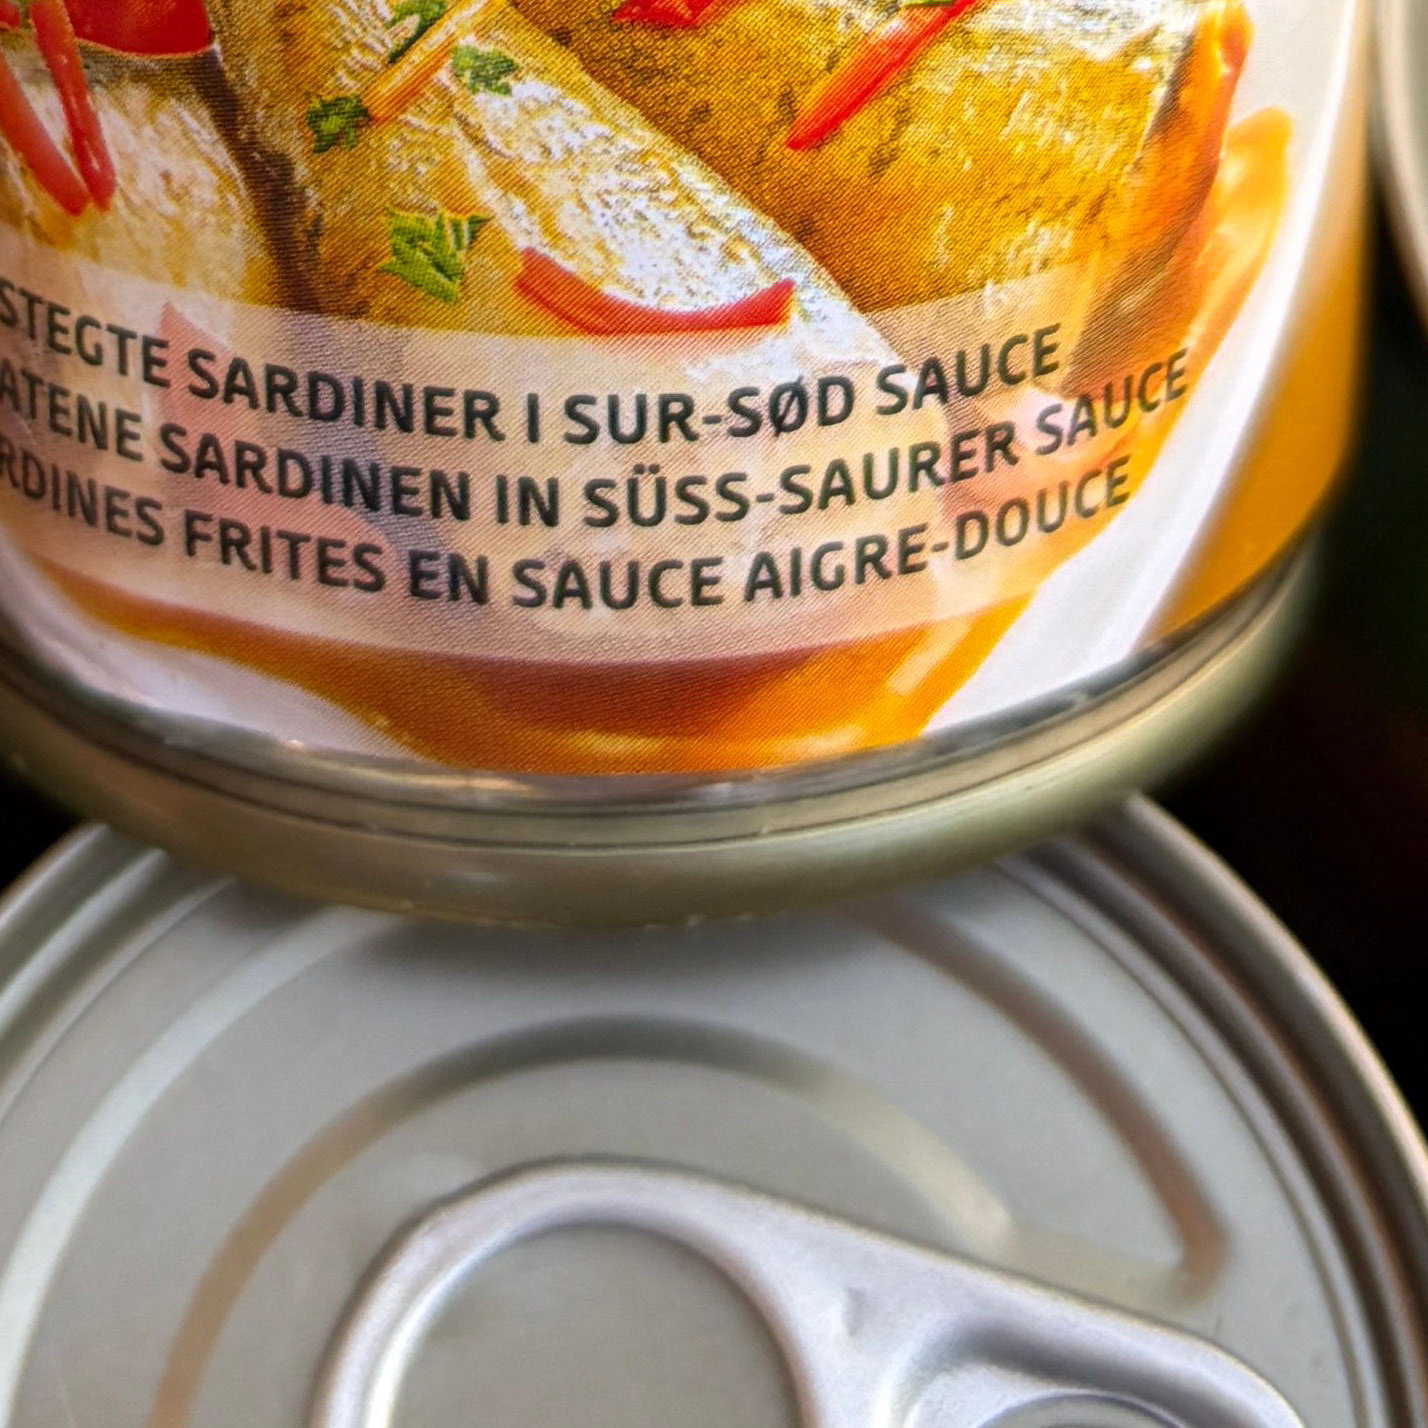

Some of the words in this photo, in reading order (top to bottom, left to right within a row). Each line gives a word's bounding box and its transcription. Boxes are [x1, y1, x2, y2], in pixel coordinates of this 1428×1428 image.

[158, 421, 474, 526] SARDINEN
[494, 474, 560, 529] IN
[581, 437, 1021, 530] SÜSS-SAURER
[1033, 346, 1192, 456] SAUCE
[186, 345, 505, 444] SARDINER
[525, 395, 540, 445] I
[564, 376, 854, 447] SUR-SØD
[874, 323, 1063, 419] SAUCE
[180, 508, 388, 594] FRITES
[407, 550, 489, 608] EN
[510, 556, 726, 612] SAUCE
[742, 454, 1132, 604] AIGRE-DOUCE
